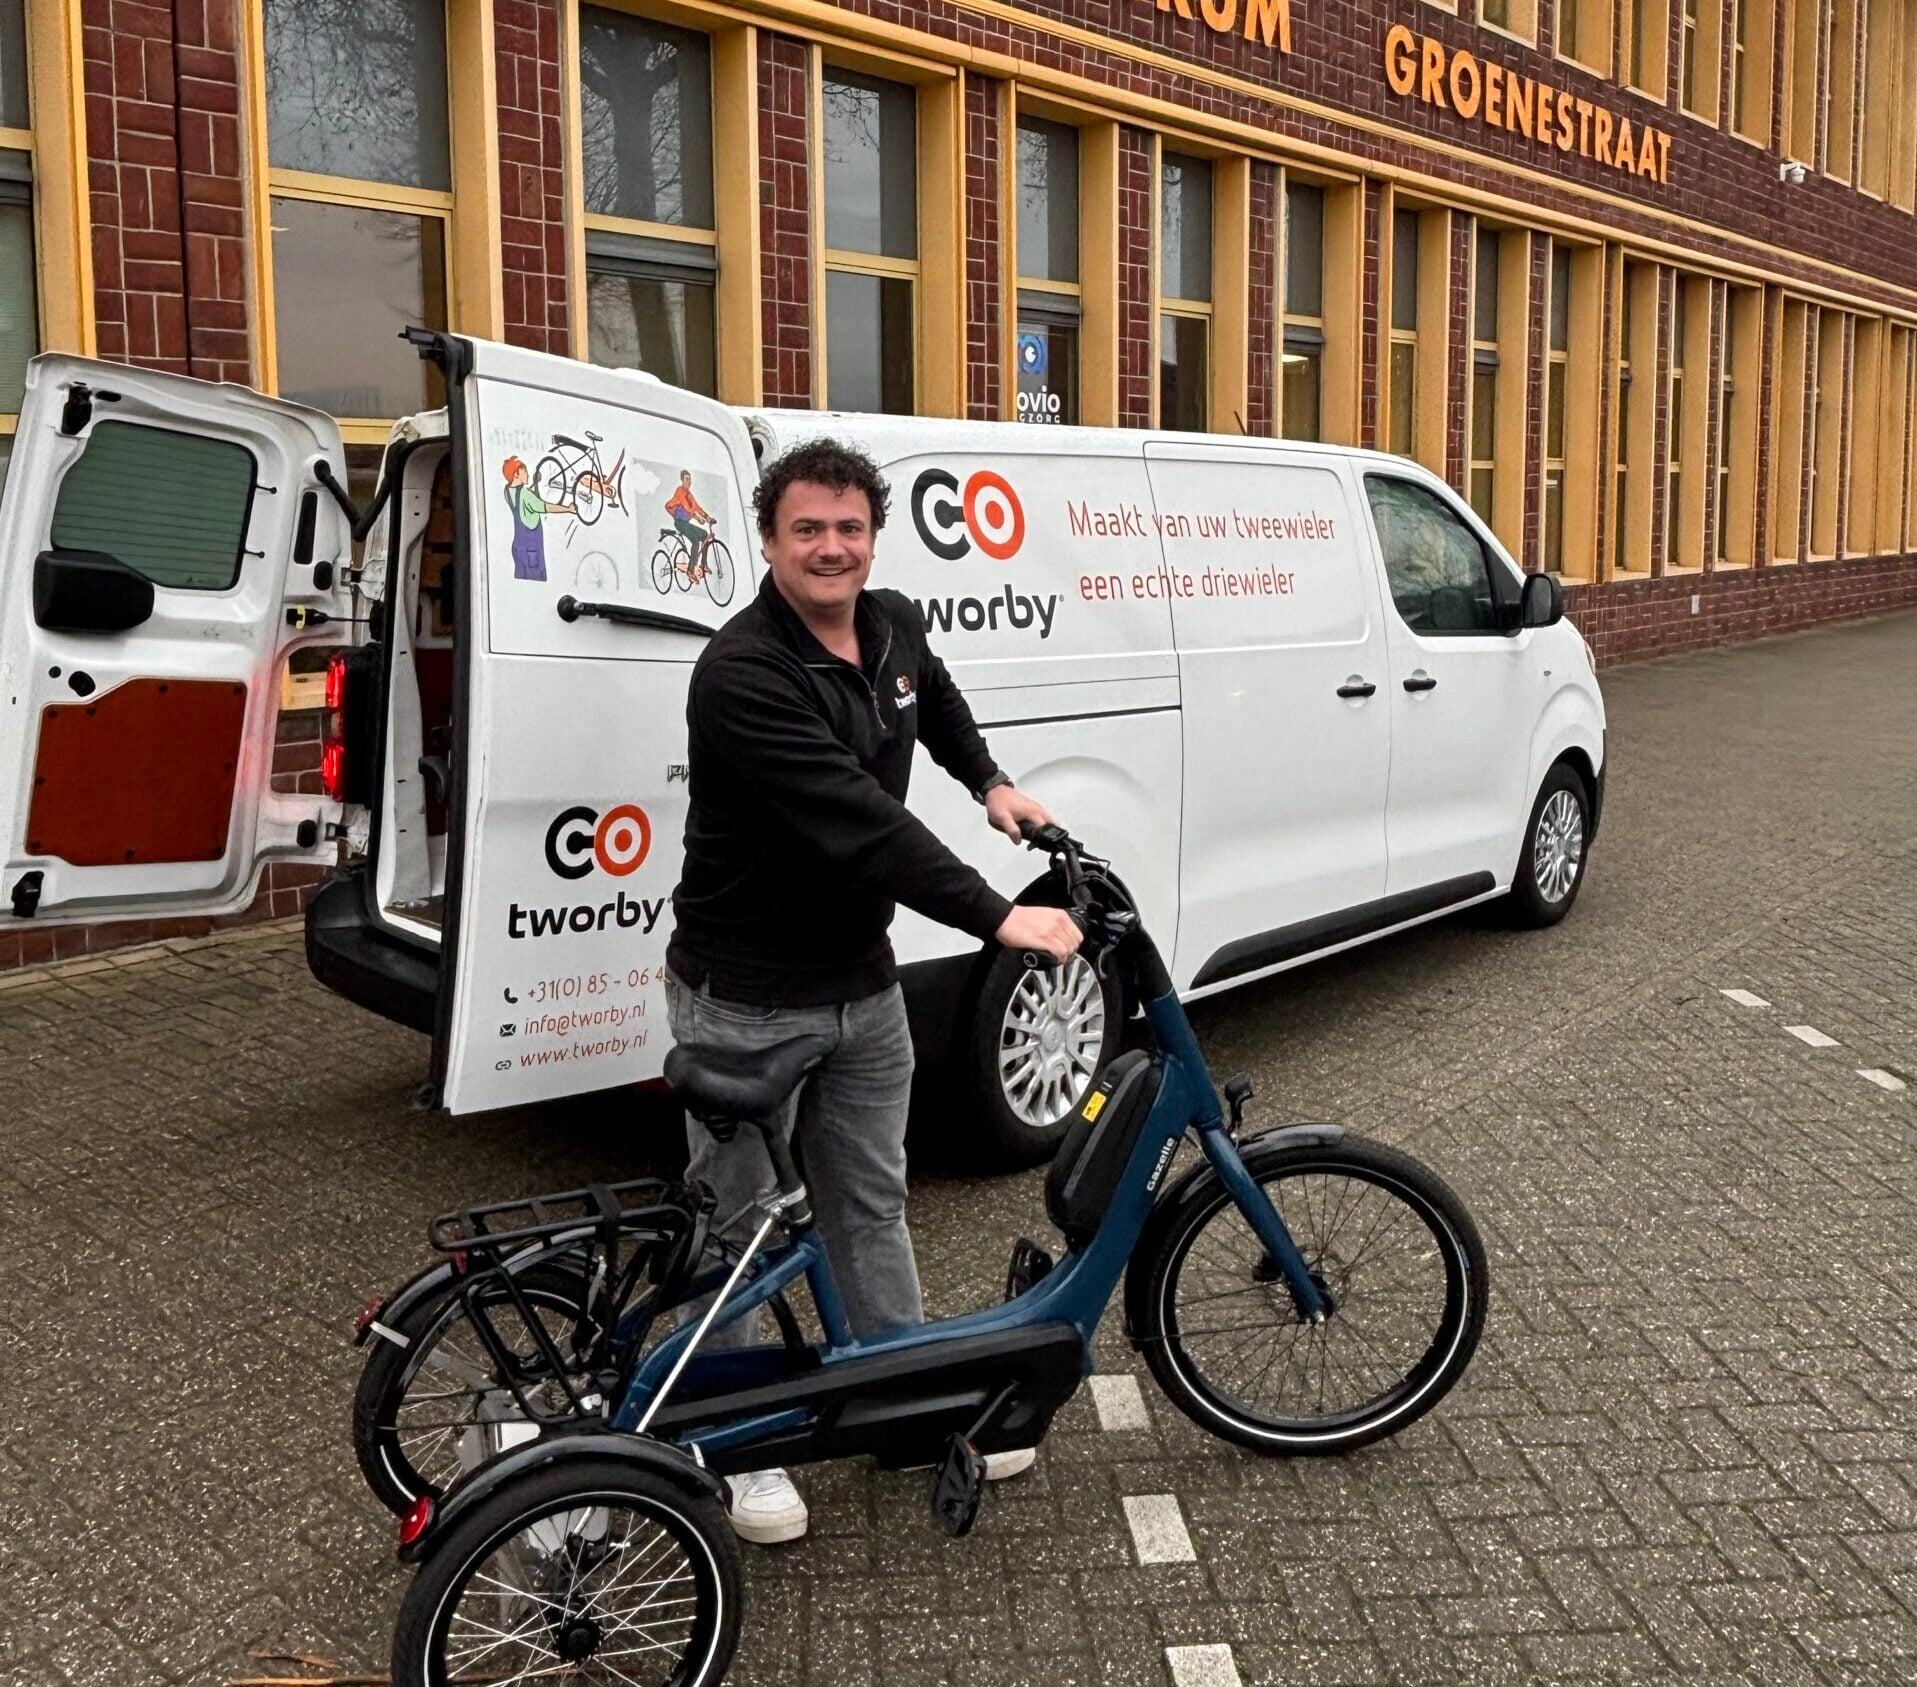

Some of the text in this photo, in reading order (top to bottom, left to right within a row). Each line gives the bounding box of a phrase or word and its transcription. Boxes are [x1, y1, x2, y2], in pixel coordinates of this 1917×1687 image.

[1385, 23, 1671, 185] GROENESTRAAT
[1016, 385, 1061, 413] ovio
[1067, 500, 1335, 540] Maakt van uw tweewieler
[1080, 563, 1295, 601] een echte driewieler
[913, 583, 1057, 640] worby
[507, 891, 666, 939] tworby
[527, 975, 582, 1003] +31(0)
[587, 973, 609, 995] 85
[628, 968, 650, 988] 06
[524, 1000, 646, 1037] info@tworby.nl
[519, 1029, 648, 1068] www.tworby.nl
[1146, 1137, 1177, 1192] Gazelle
